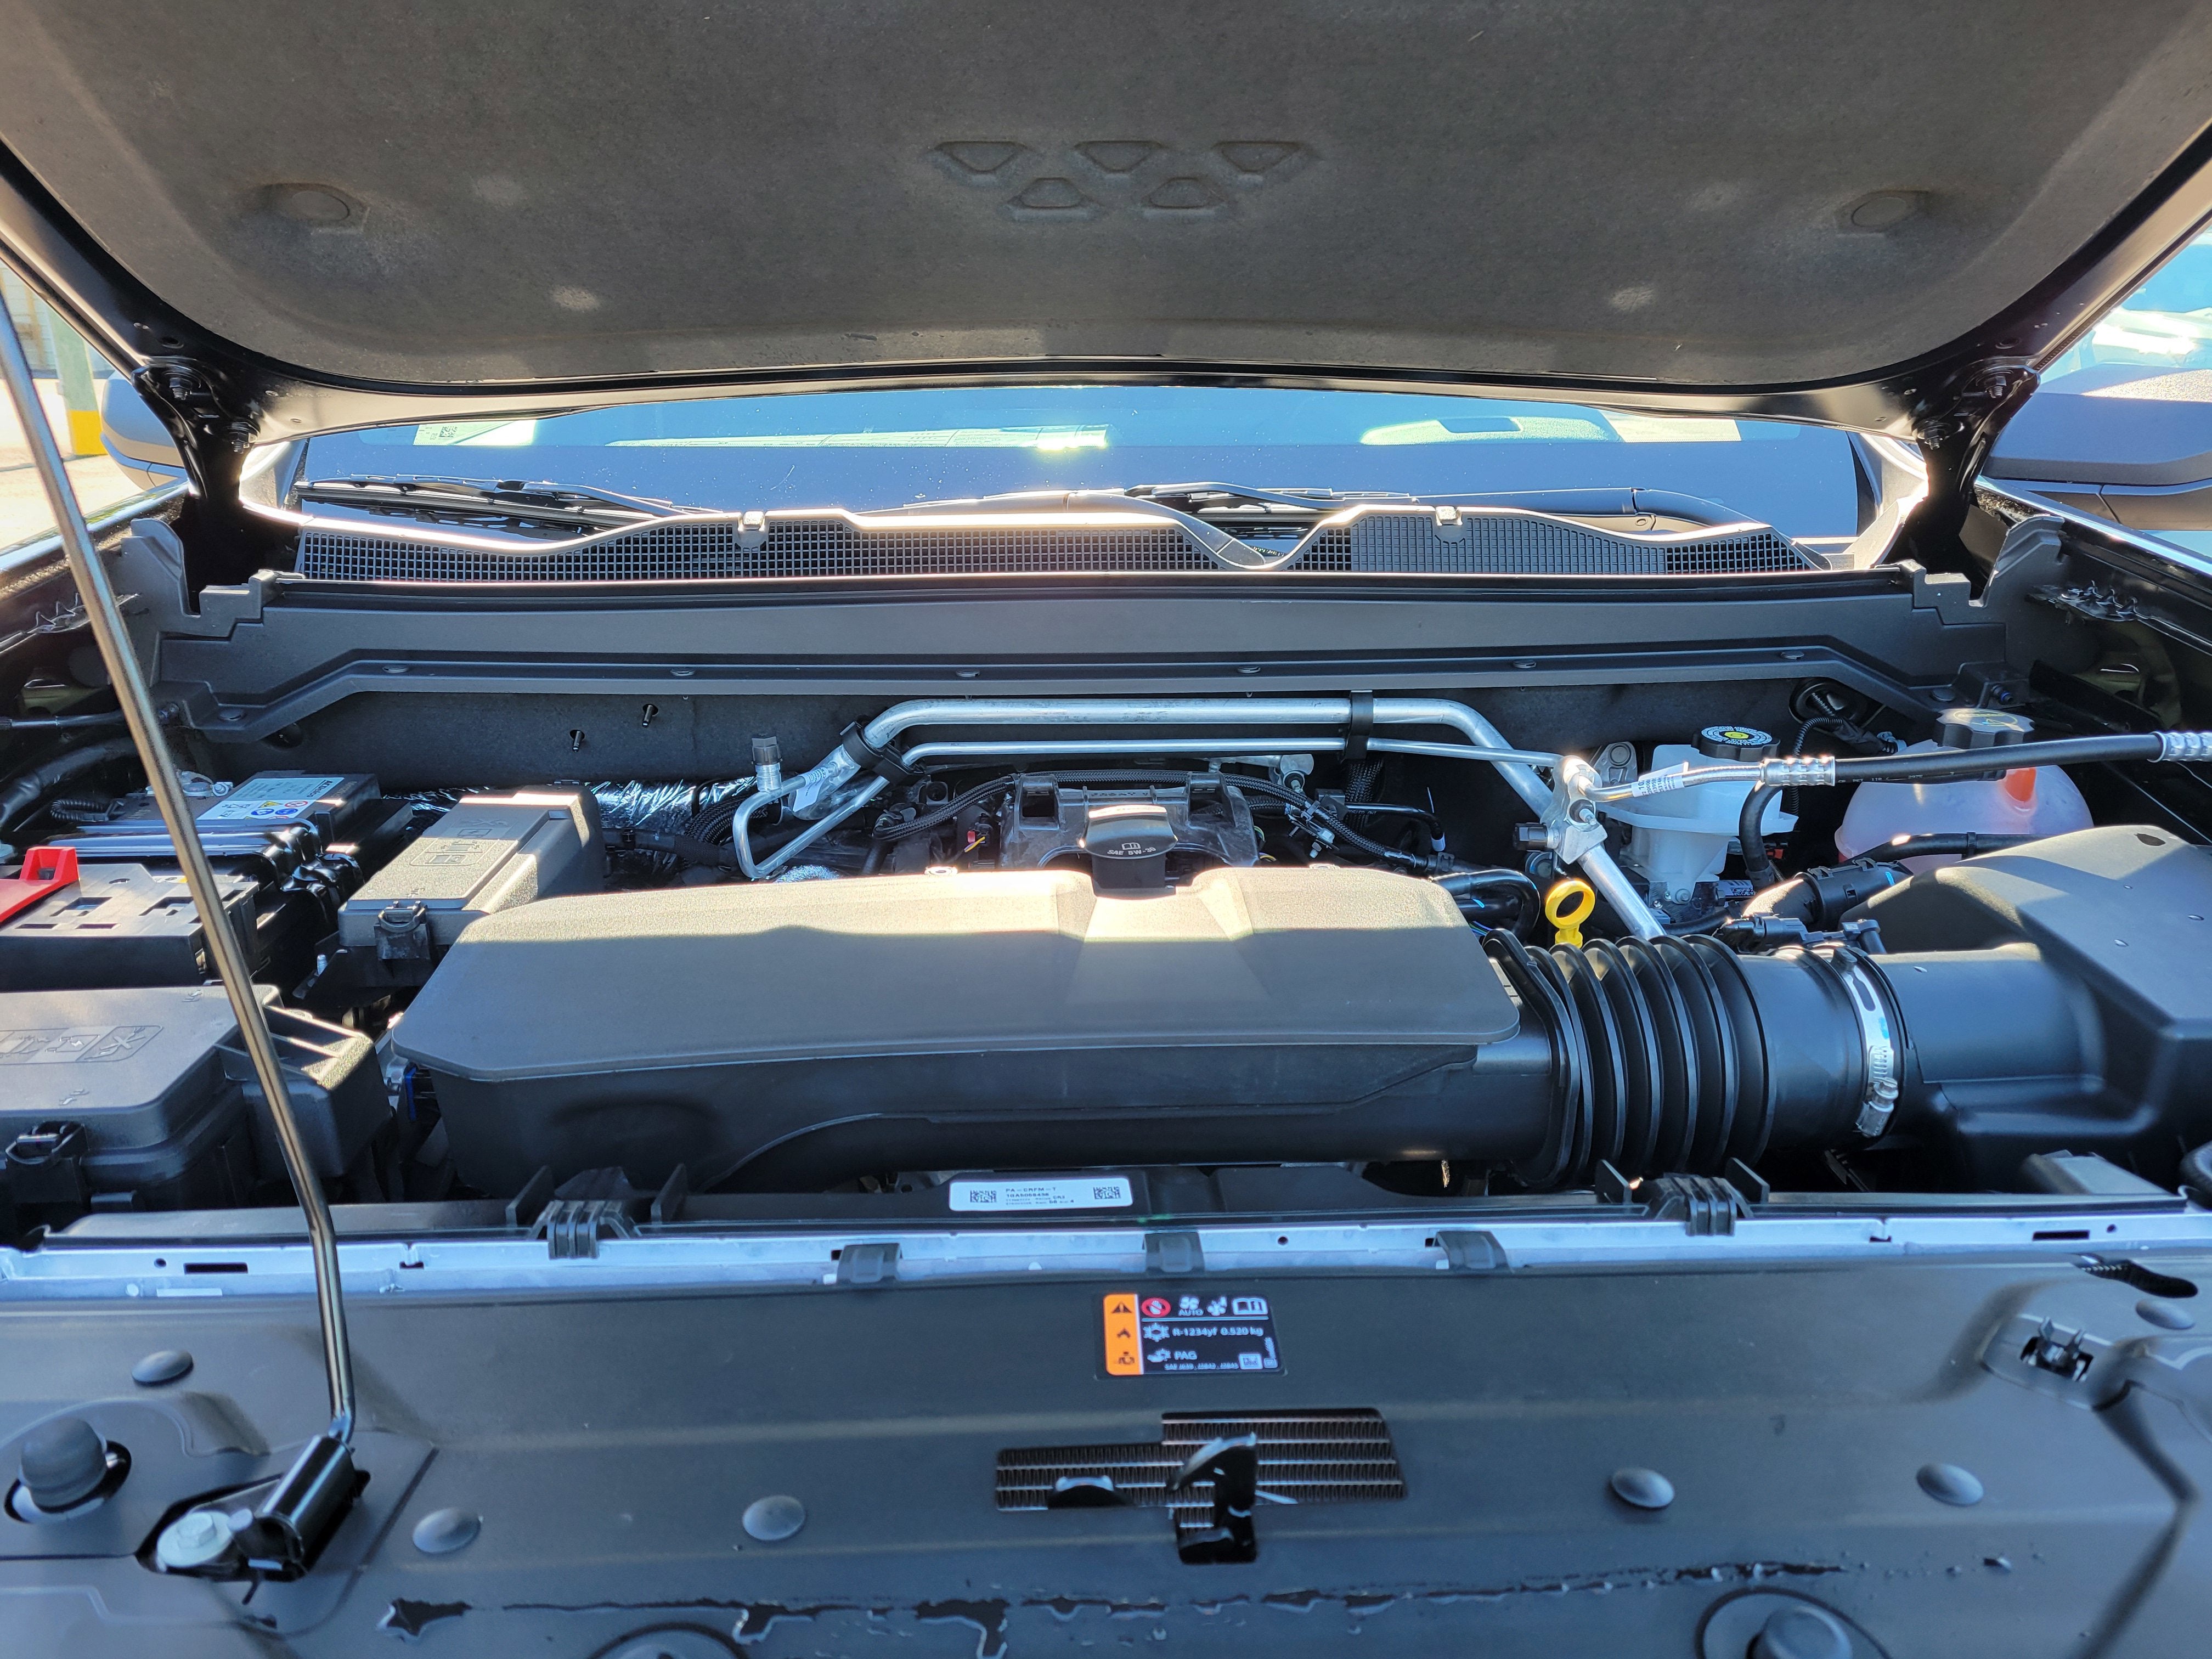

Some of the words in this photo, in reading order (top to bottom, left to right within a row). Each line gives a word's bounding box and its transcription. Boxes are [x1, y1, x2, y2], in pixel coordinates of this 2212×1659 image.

[306, 780, 334, 798] ACDelco
[1172, 1327, 1217, 1338] R-1234yf
[1220, 1327, 1249, 1336] 0.520
[1249, 1326, 1264, 1337] kg
[1174, 1351, 1198, 1360] PAG
